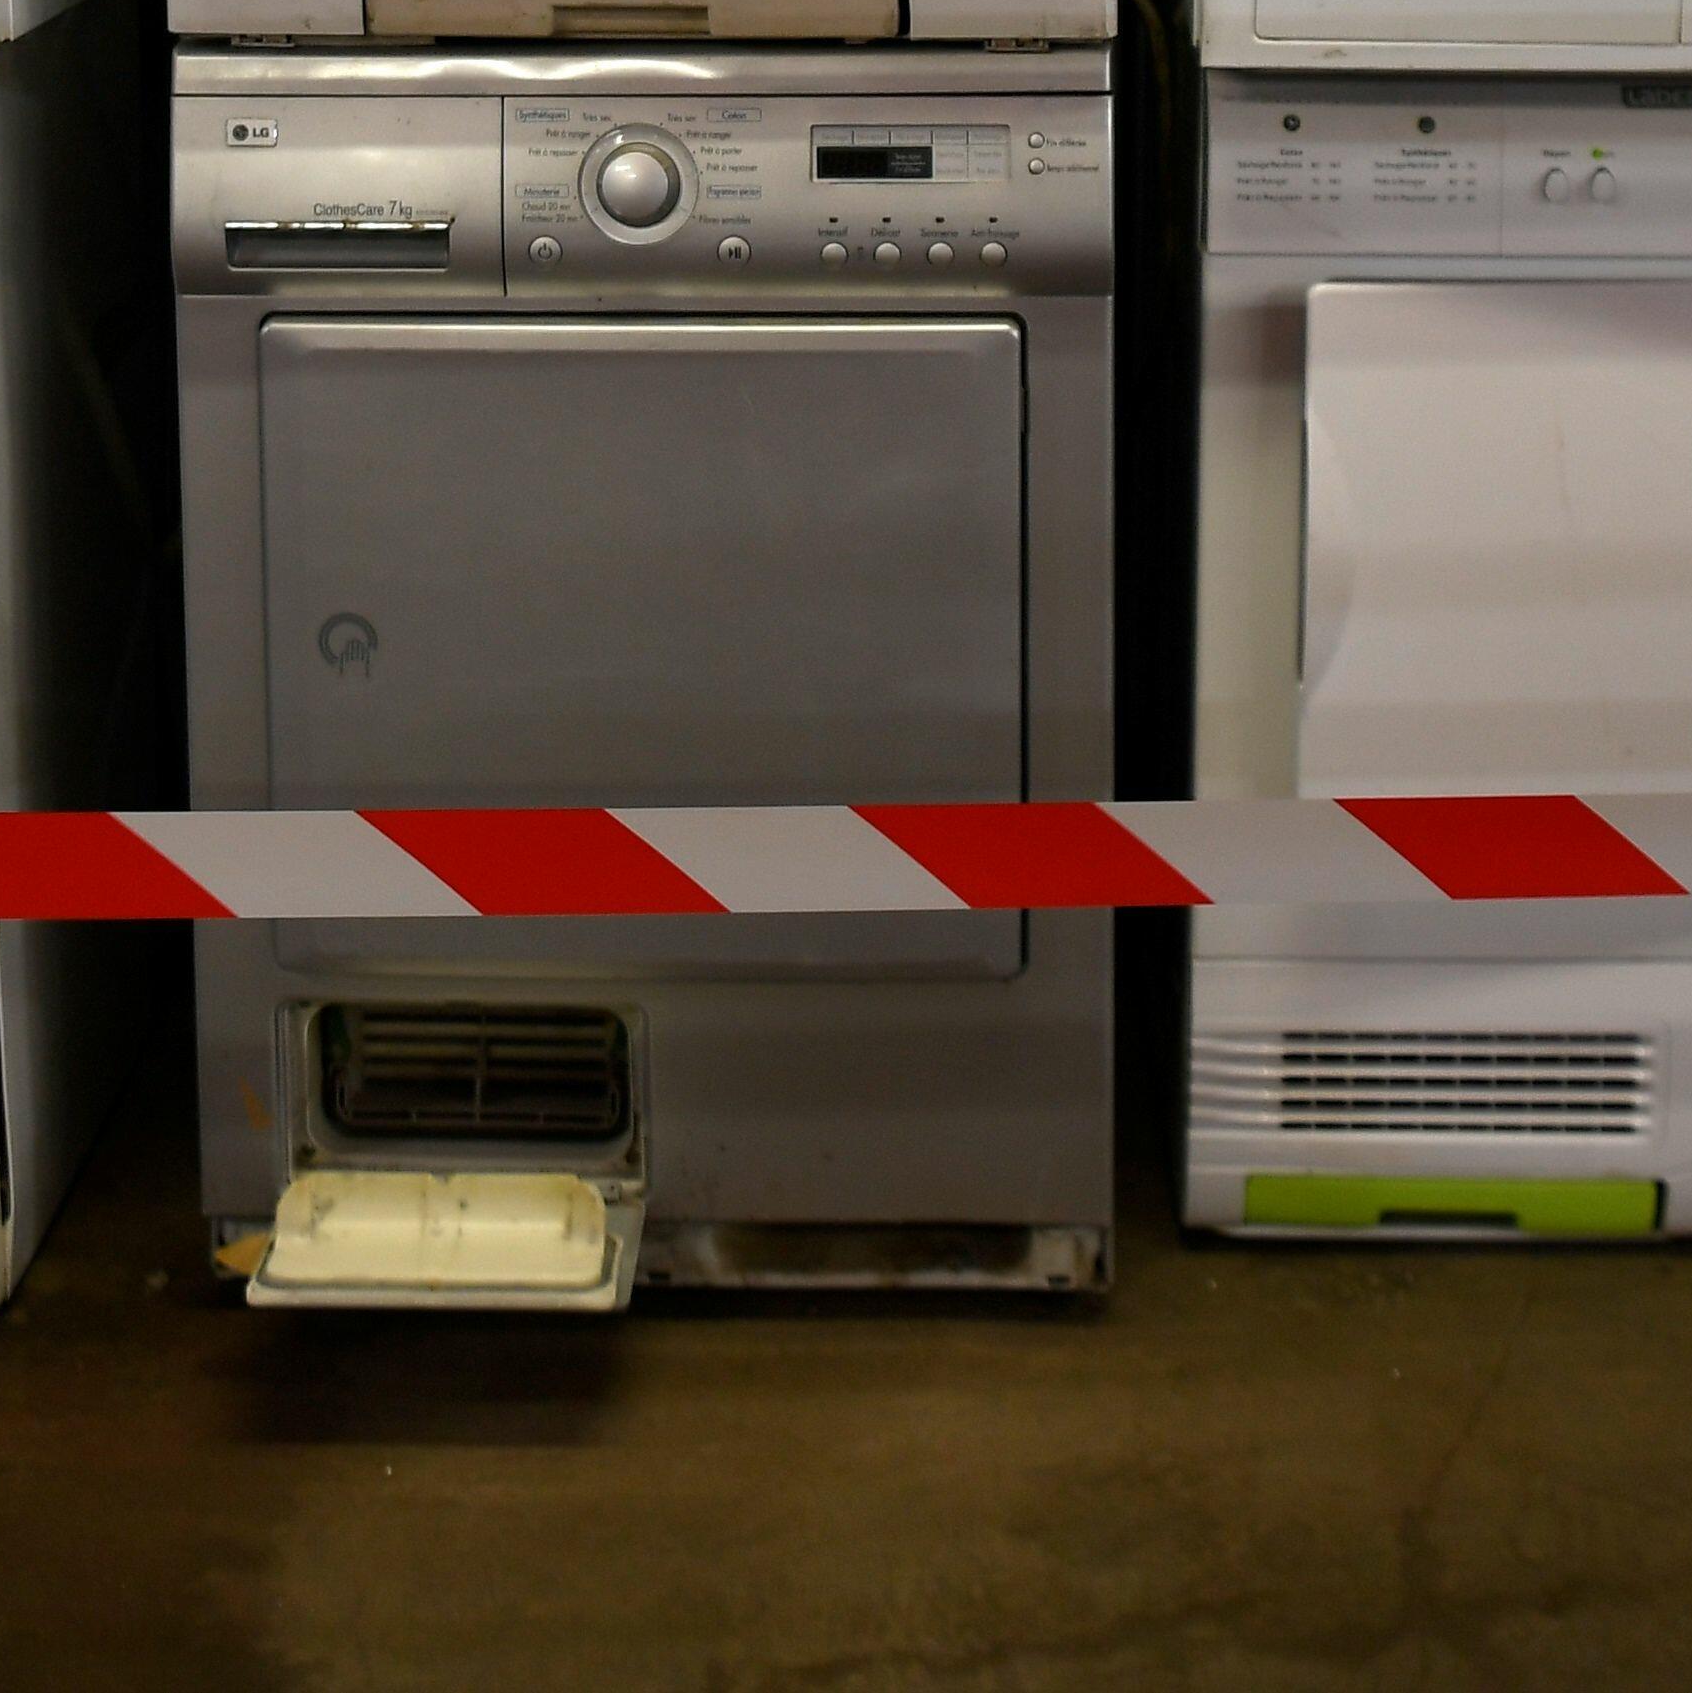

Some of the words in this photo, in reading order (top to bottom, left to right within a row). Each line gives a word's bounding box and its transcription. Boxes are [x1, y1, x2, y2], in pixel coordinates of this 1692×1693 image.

[252, 127, 269, 138] LG
[313, 202, 385, 217] ClothesCare
[521, 202, 547, 212] Chaud
[548, 202, 559, 212] 20
